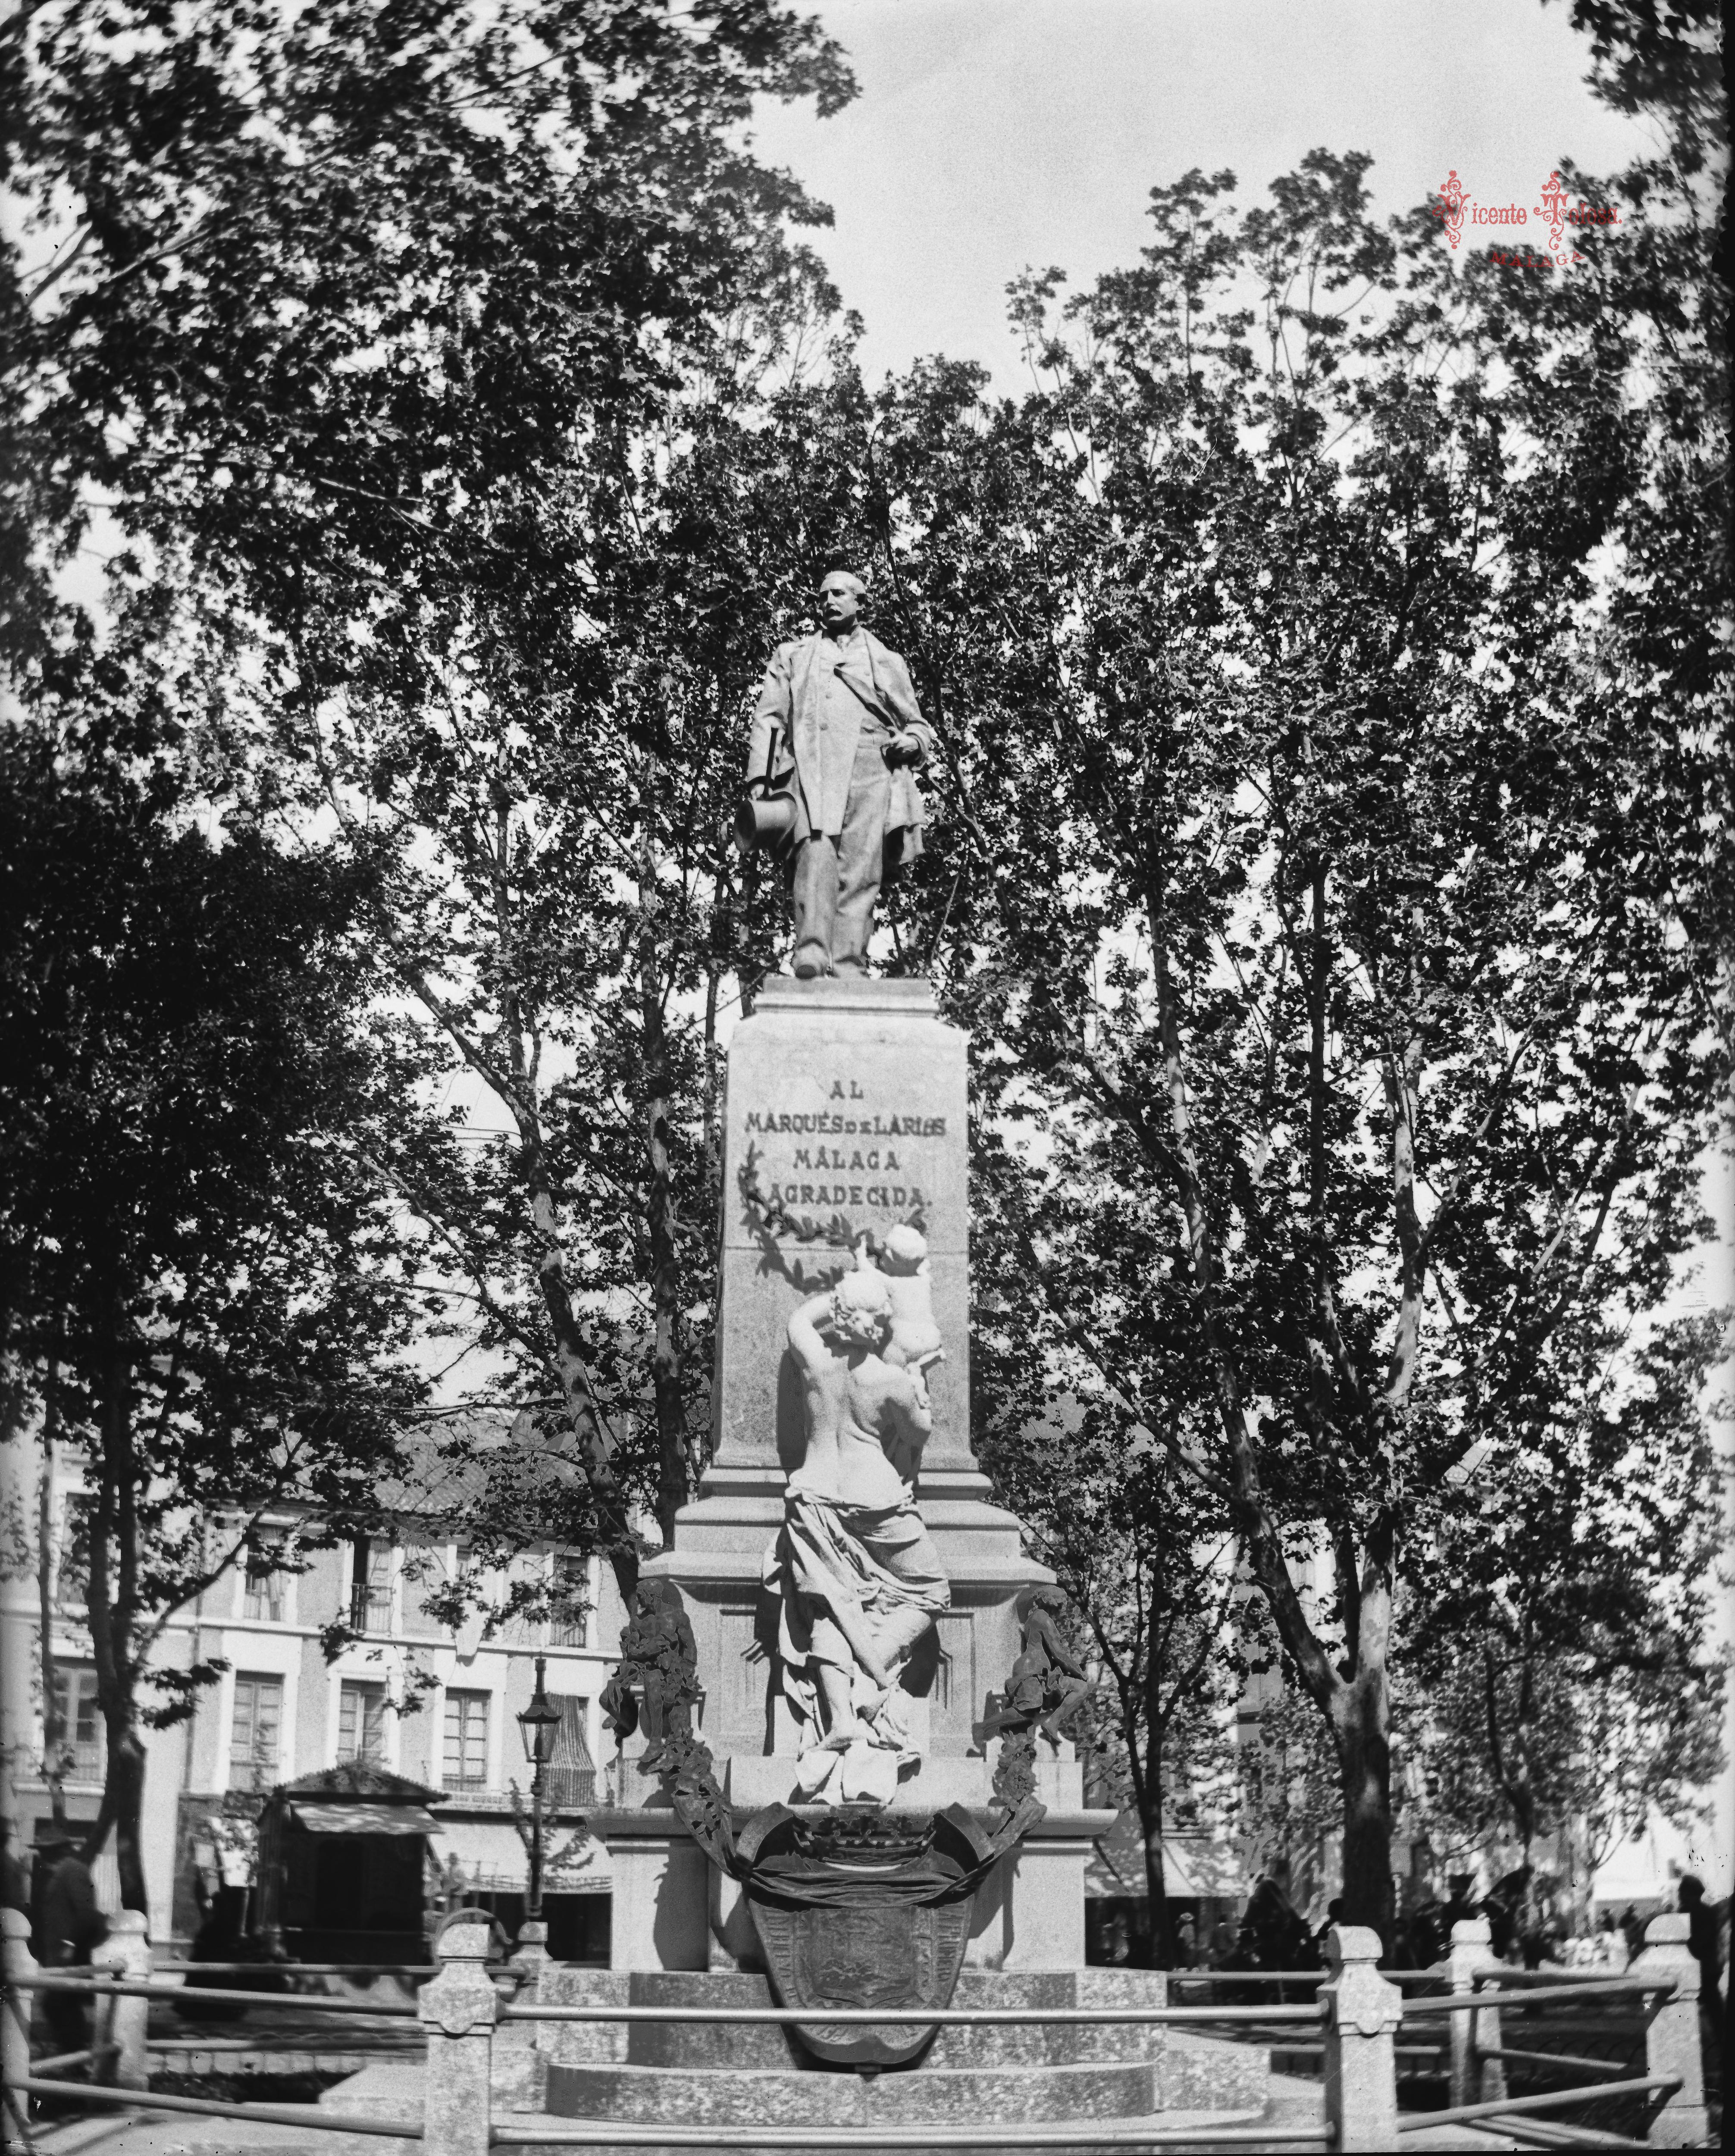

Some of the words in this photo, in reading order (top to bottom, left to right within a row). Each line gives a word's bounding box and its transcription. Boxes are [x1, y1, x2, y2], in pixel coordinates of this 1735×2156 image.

[830, 1080, 864, 1100] AL
[744, 1111, 844, 1134] MARQUÉS
[845, 1121, 871, 1135] DE
[767, 1183, 932, 1208] AGRADECIDA.
